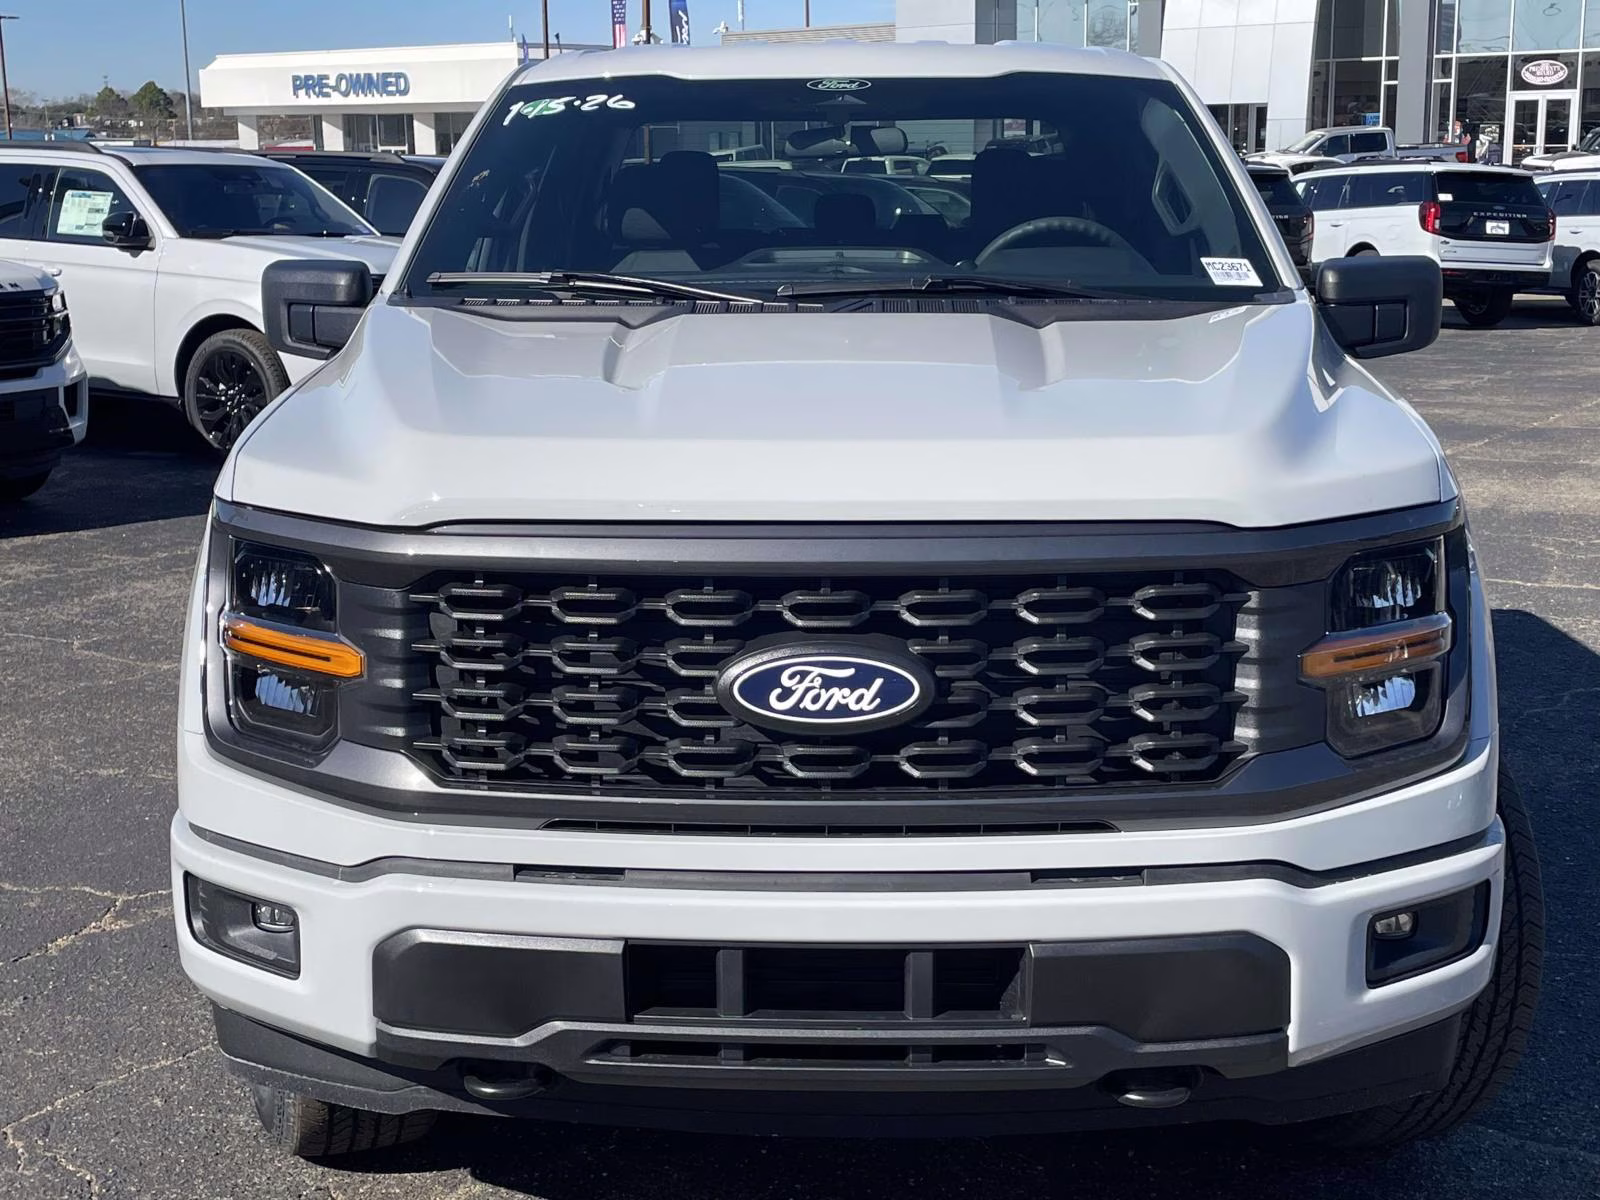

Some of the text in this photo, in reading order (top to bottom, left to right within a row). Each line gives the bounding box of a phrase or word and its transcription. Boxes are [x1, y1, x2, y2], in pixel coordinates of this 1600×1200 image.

[291, 72, 410, 98] PRE-OWNED
[818, 79, 861, 89] Ford
[1205, 261, 1252, 273] MC23671
[768, 665, 884, 711] Ford
